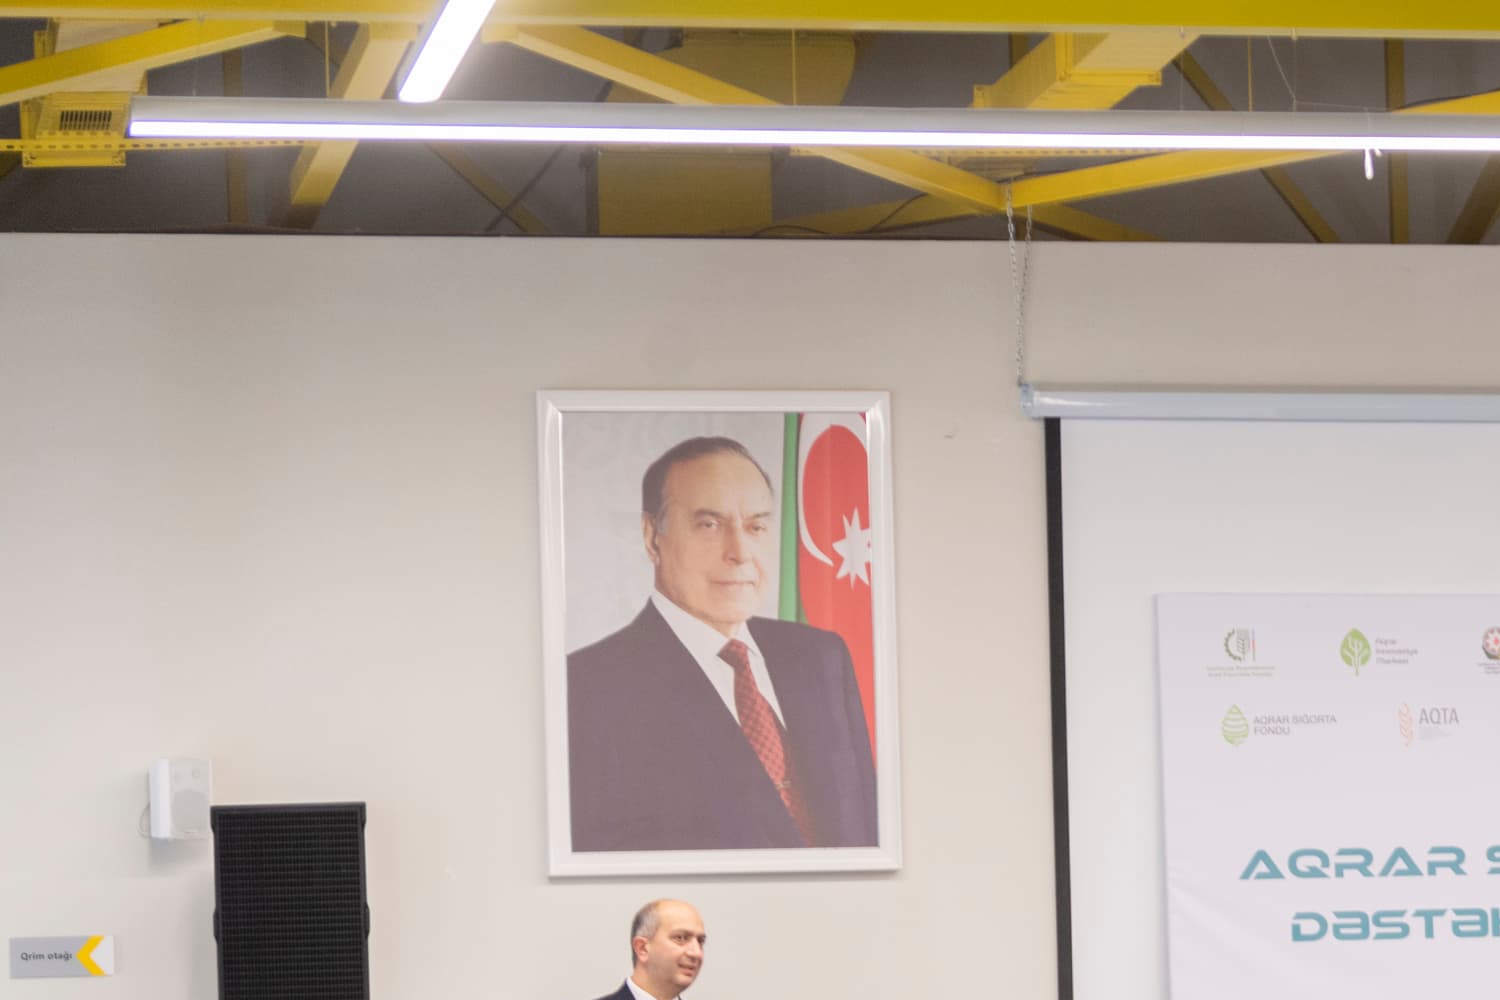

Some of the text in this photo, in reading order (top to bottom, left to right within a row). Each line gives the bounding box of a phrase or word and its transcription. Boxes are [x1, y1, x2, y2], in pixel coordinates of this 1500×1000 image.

[1418, 707, 1460, 725] AQTA
[1254, 726, 1290, 736] FONDU
[1239, 846, 1468, 881] AQRAR
